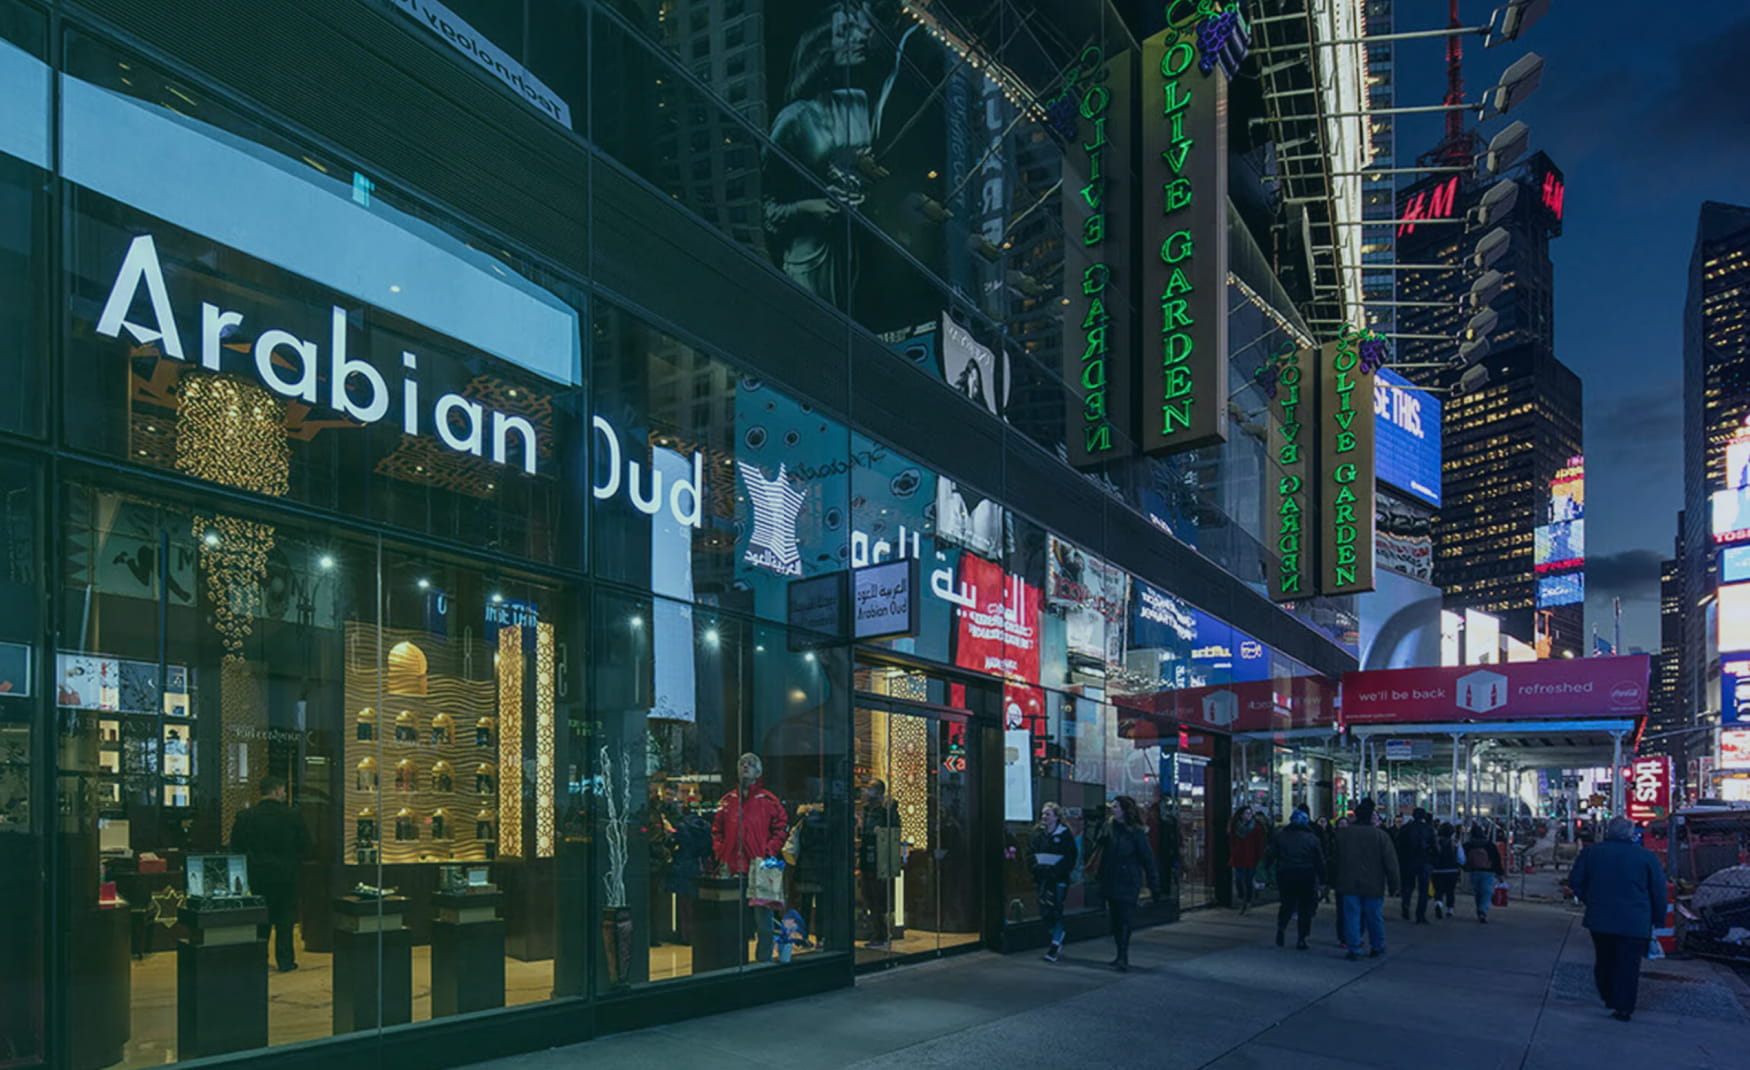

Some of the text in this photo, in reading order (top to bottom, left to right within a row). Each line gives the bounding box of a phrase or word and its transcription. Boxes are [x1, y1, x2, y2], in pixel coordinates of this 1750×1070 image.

[1160, 42, 1195, 435] OLIVE GARDEN
[96, 234, 537, 476] Arabian
[1391, 386, 1424, 439] THIS.
[1333, 350, 1358, 587] OLIVE GARDEN
[857, 600, 907, 620] Arabian Oud
[1358, 681, 1594, 702] we'll be back refreshed
[1636, 759, 1664, 802] tkts
